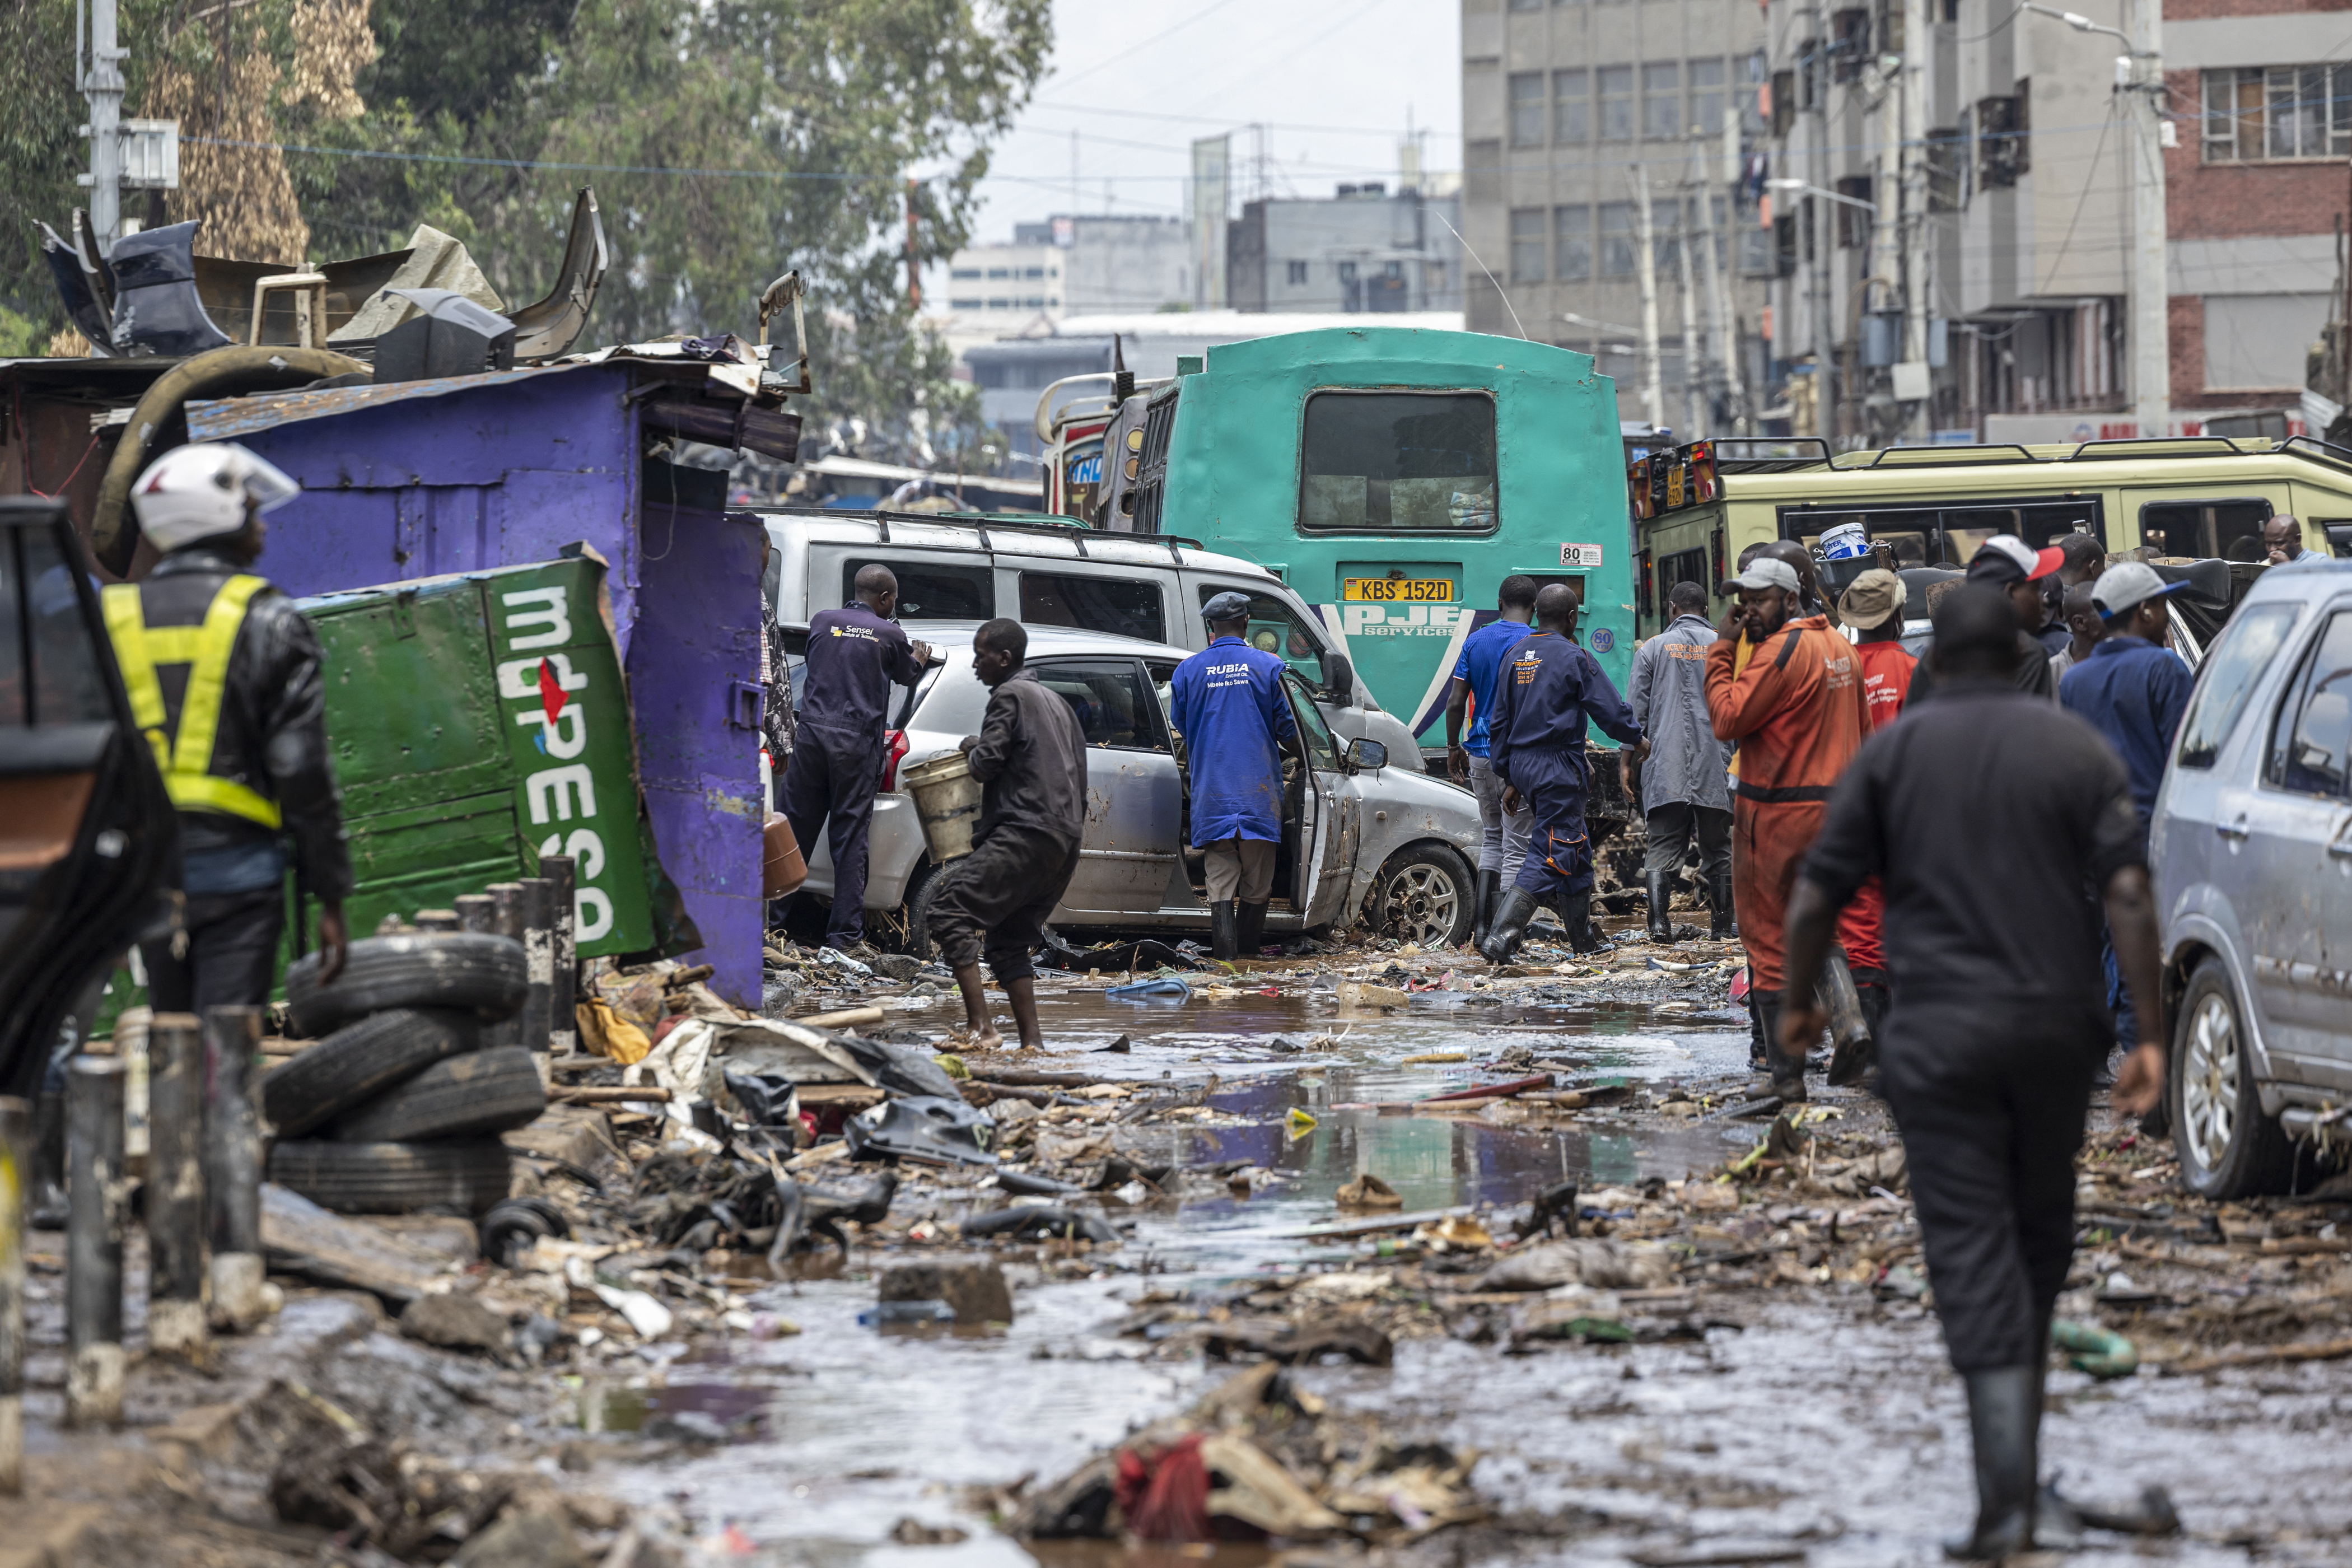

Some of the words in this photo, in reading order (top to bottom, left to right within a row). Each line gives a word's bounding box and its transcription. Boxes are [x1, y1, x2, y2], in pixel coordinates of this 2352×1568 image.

[1564, 548, 1580, 559] 80
[1362, 581, 1396, 600] KBS
[1403, 581, 1447, 600] 152D
[1344, 605, 1459, 636] PJE
[845, 625, 874, 635] Sensei
[1364, 626, 1459, 636] services
[861, 634, 880, 643] Technology
[1594, 632, 1611, 644] 80
[1664, 643, 1687, 652] VICTORY
